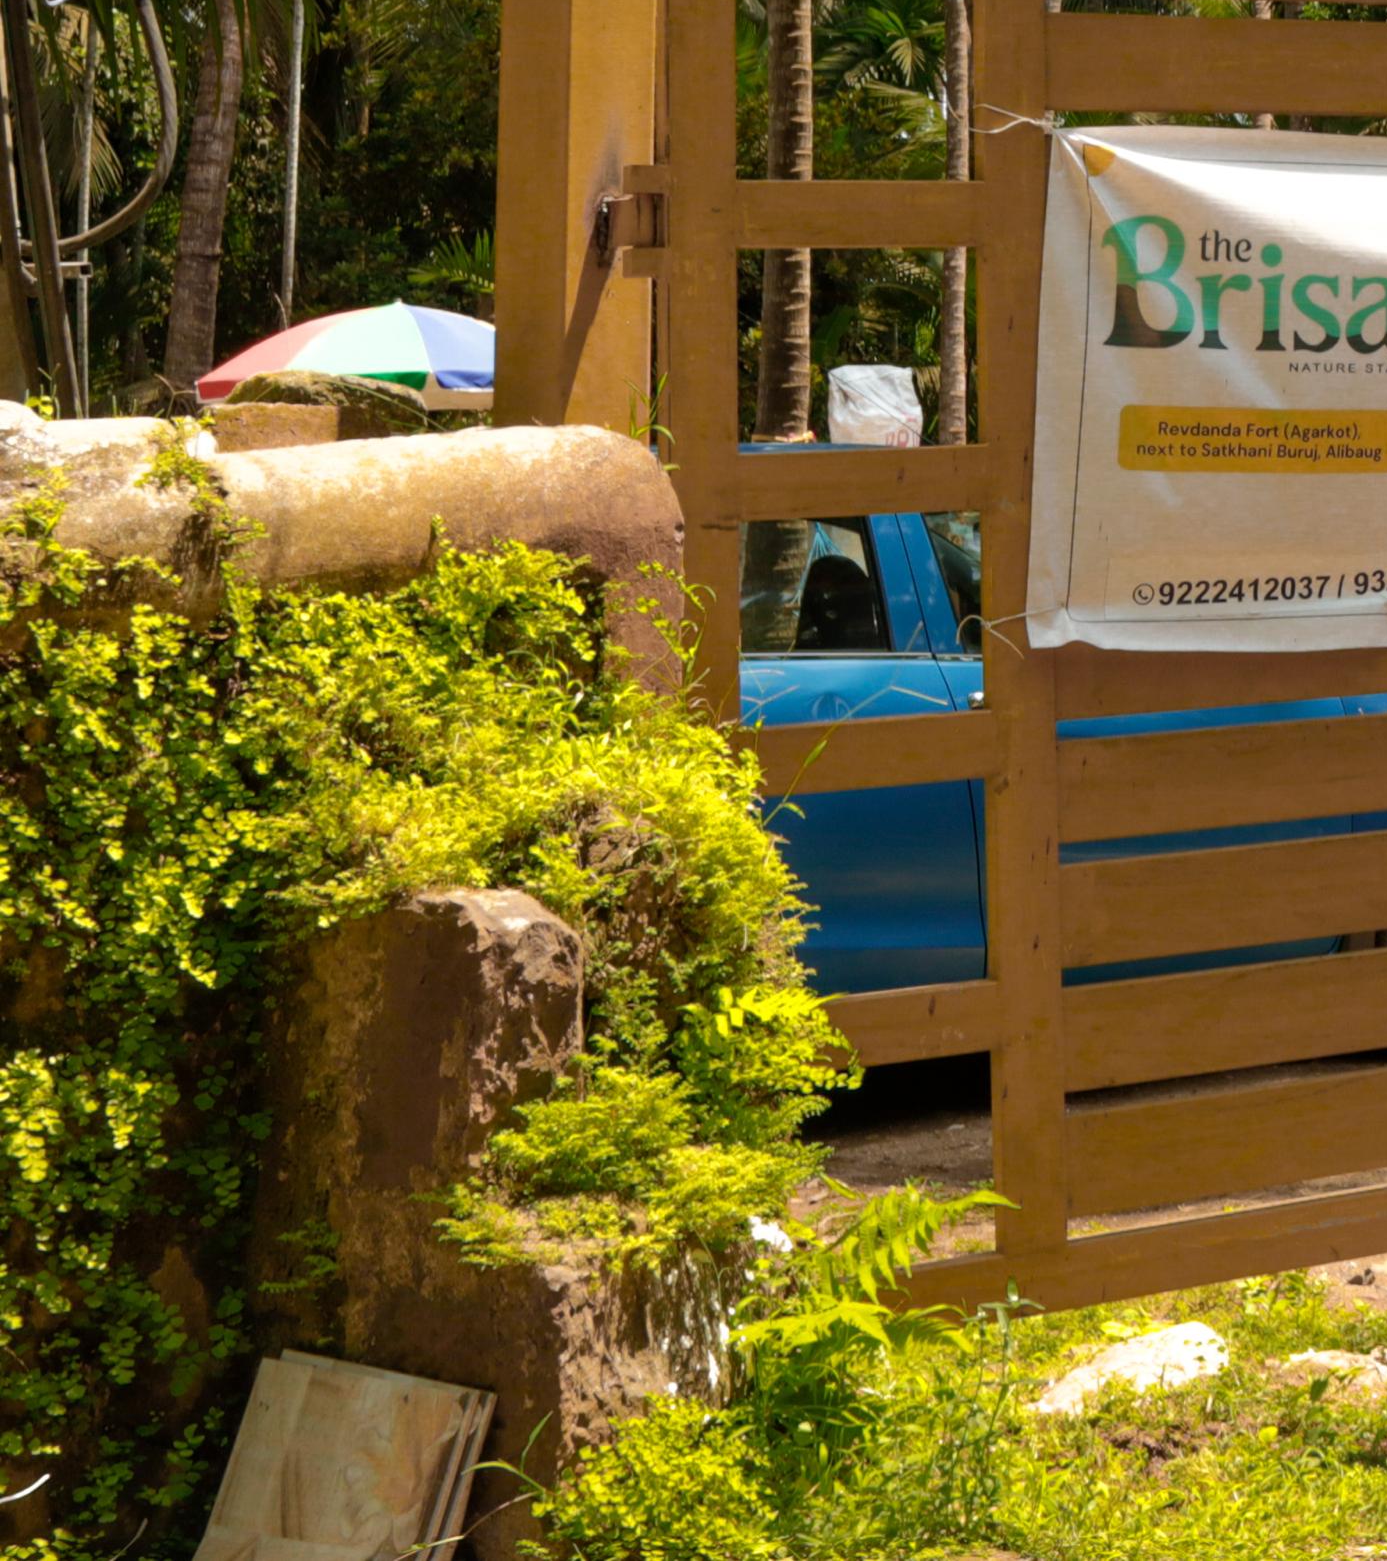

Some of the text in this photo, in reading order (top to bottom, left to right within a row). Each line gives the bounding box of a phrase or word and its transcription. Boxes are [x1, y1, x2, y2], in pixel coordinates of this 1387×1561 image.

[1198, 230, 1253, 263] the
[1288, 362, 1357, 374] NATURE
[1158, 421, 1361, 442] Revdanda Fort (Agarkot),
[1136, 442, 1382, 462] next to Satkhani Buruj, Alibaug
[1158, 574, 1331, 606] 9222412037
